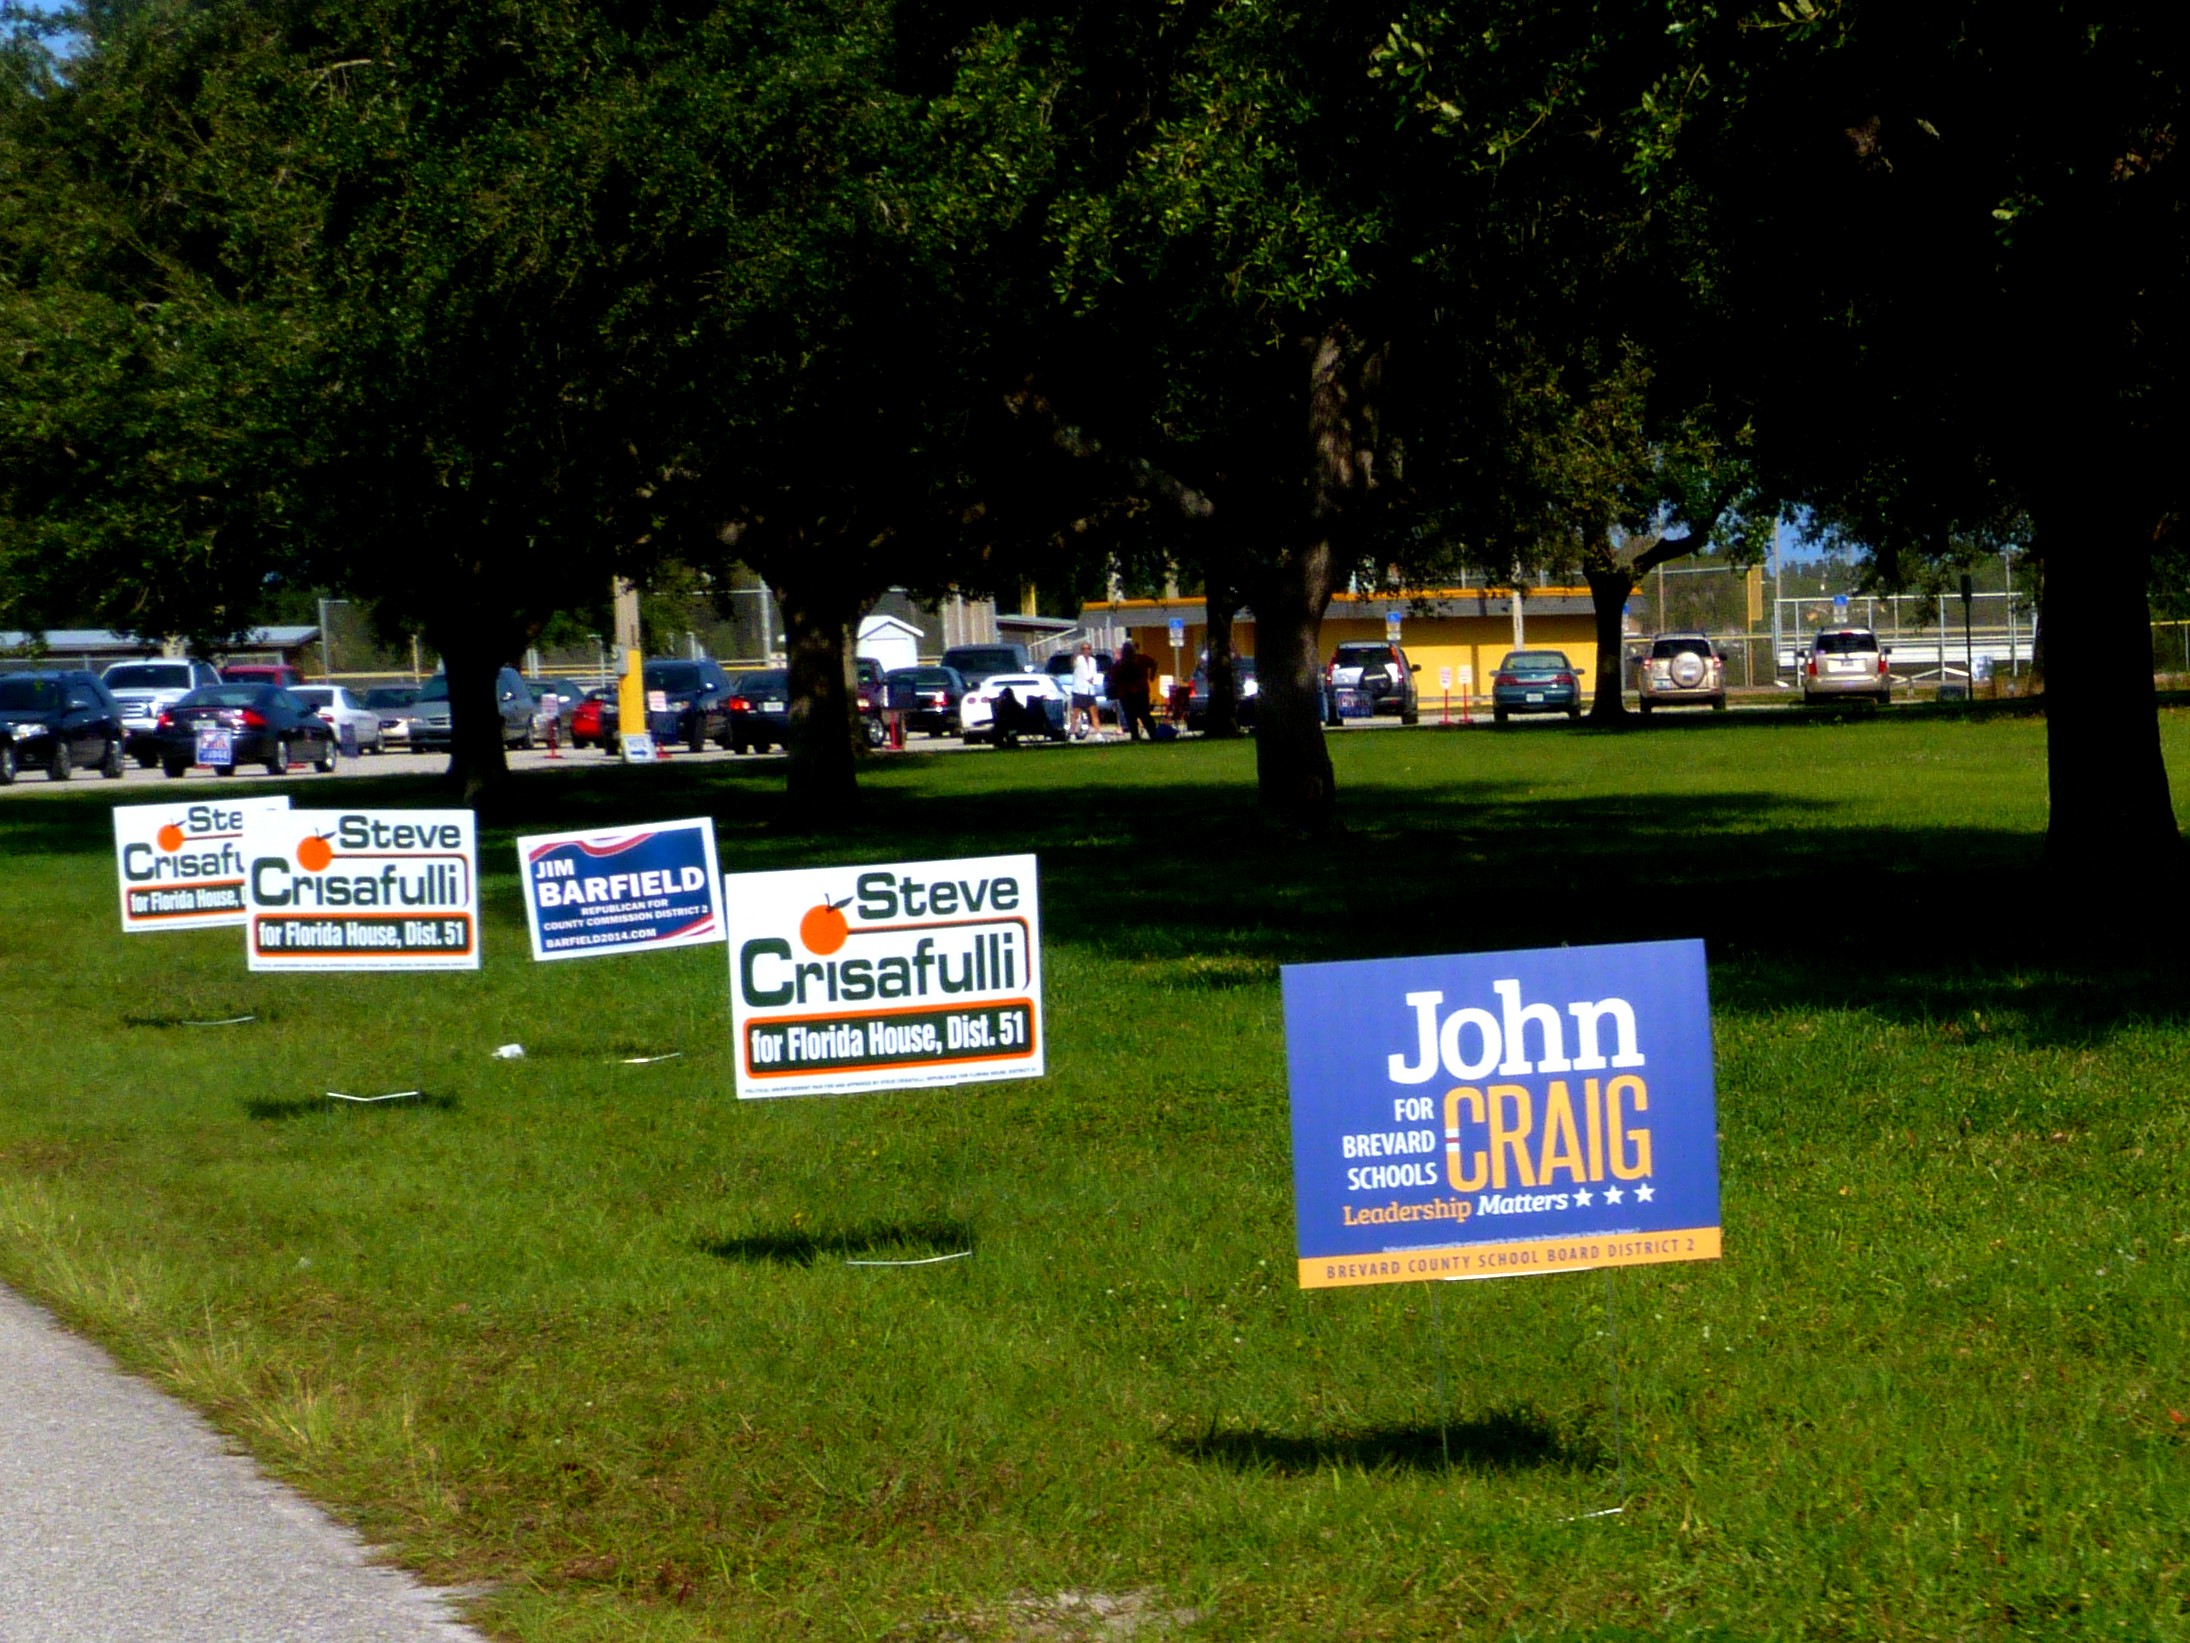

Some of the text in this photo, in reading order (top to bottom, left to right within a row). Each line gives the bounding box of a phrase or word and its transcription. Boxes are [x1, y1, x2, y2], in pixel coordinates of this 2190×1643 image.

[339, 815, 462, 849] Steve
[251, 856, 457, 907] Crisafulli
[535, 858, 575, 879] JIM
[150, 890, 195, 912] Florida
[537, 866, 705, 907] BARFIELD
[856, 871, 1019, 920] Steve
[543, 919, 584, 931] COUNTY
[586, 912, 653, 927] COMMISSION
[655, 906, 700, 919] DISTRICT
[581, 898, 669, 916] REPUBLICAN FOR
[259, 922, 283, 946] for
[286, 921, 342, 946] Florida
[346, 921, 402, 949] House,
[404, 921, 442, 945] Dist.
[445, 921, 464, 945] 51
[546, 928, 657, 949] BARFIELD2014.COM
[740, 931, 1015, 1008] Crisafulli
[751, 1011, 1025, 1064] for Florida House, Dist. 51
[1388, 978, 1646, 1085] John
[1394, 1098, 1435, 1122] FOR
[1342, 1130, 1436, 1159] BREVARD
[1443, 1074, 1652, 1194] CRAIG
[1347, 1162, 1438, 1191] SCHOOLS
[1342, 1192, 1569, 1227] Leadership Matters
[1326, 1261, 1401, 1280] BREVARD
[1408, 1255, 1471, 1274] COUNTY
[1477, 1250, 1540, 1269] SCHOOL
[1546, 1245, 1601, 1264] BOARD
[1607, 1239, 1680, 1259] DISTRICT
[1686, 1238, 1696, 1252] 2
